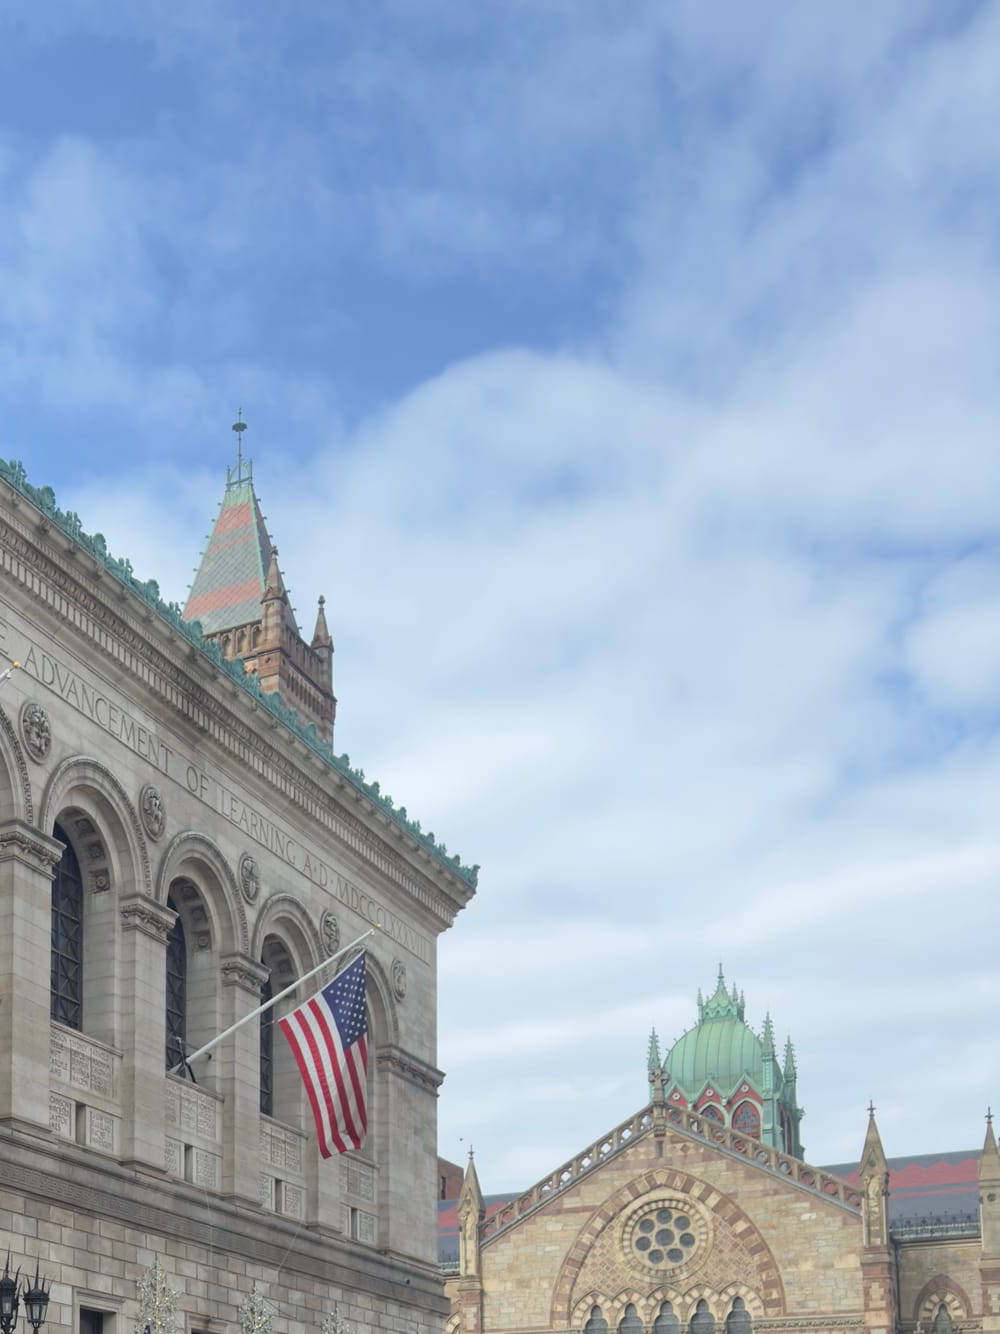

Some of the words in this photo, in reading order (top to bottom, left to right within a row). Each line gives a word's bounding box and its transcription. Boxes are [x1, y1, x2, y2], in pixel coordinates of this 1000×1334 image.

[23, 646, 173, 774] ADVANCEMENT
[186, 766, 209, 798] OF
[220, 790, 296, 864] LEARNING
